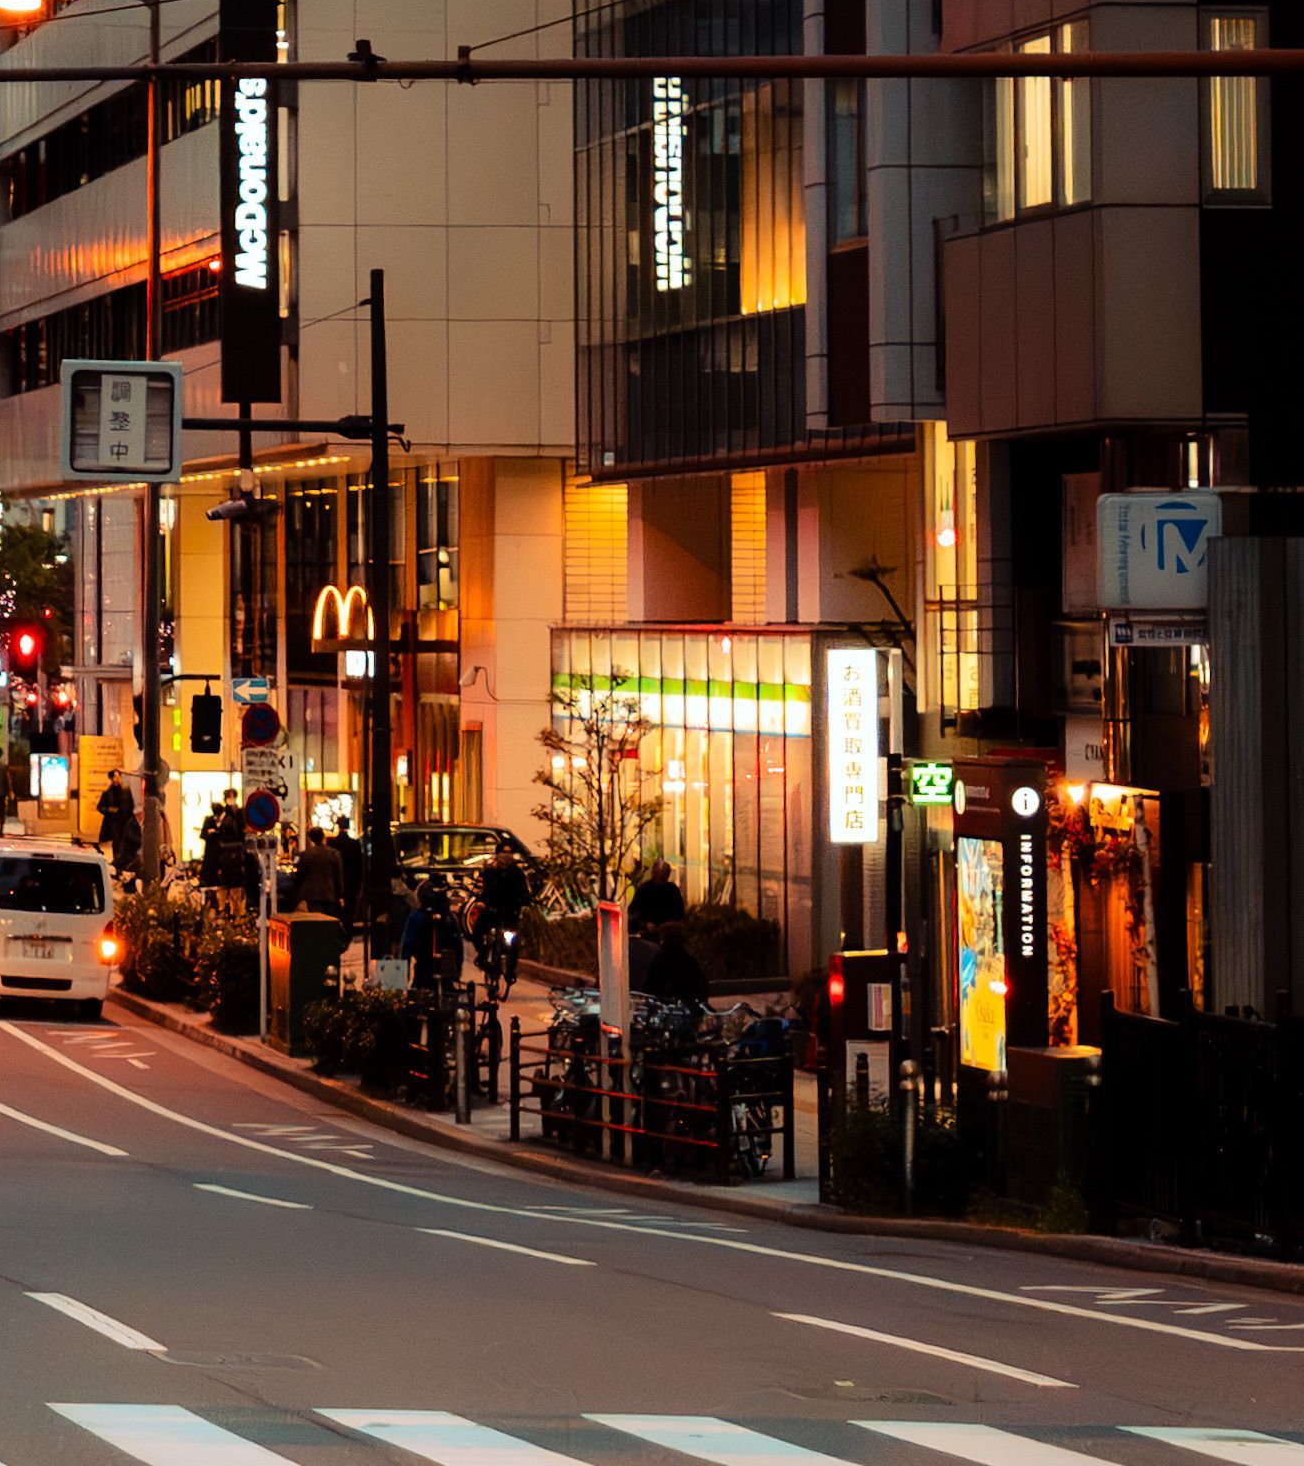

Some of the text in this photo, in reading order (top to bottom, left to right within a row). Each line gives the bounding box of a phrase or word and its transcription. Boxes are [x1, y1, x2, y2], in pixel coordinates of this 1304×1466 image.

[234, 77, 268, 290] McDonald's
[843, 664, 864, 829] お酒買取専門店
[912, 763, 953, 804] 空
[1020, 834, 1034, 957] INFORMATION
